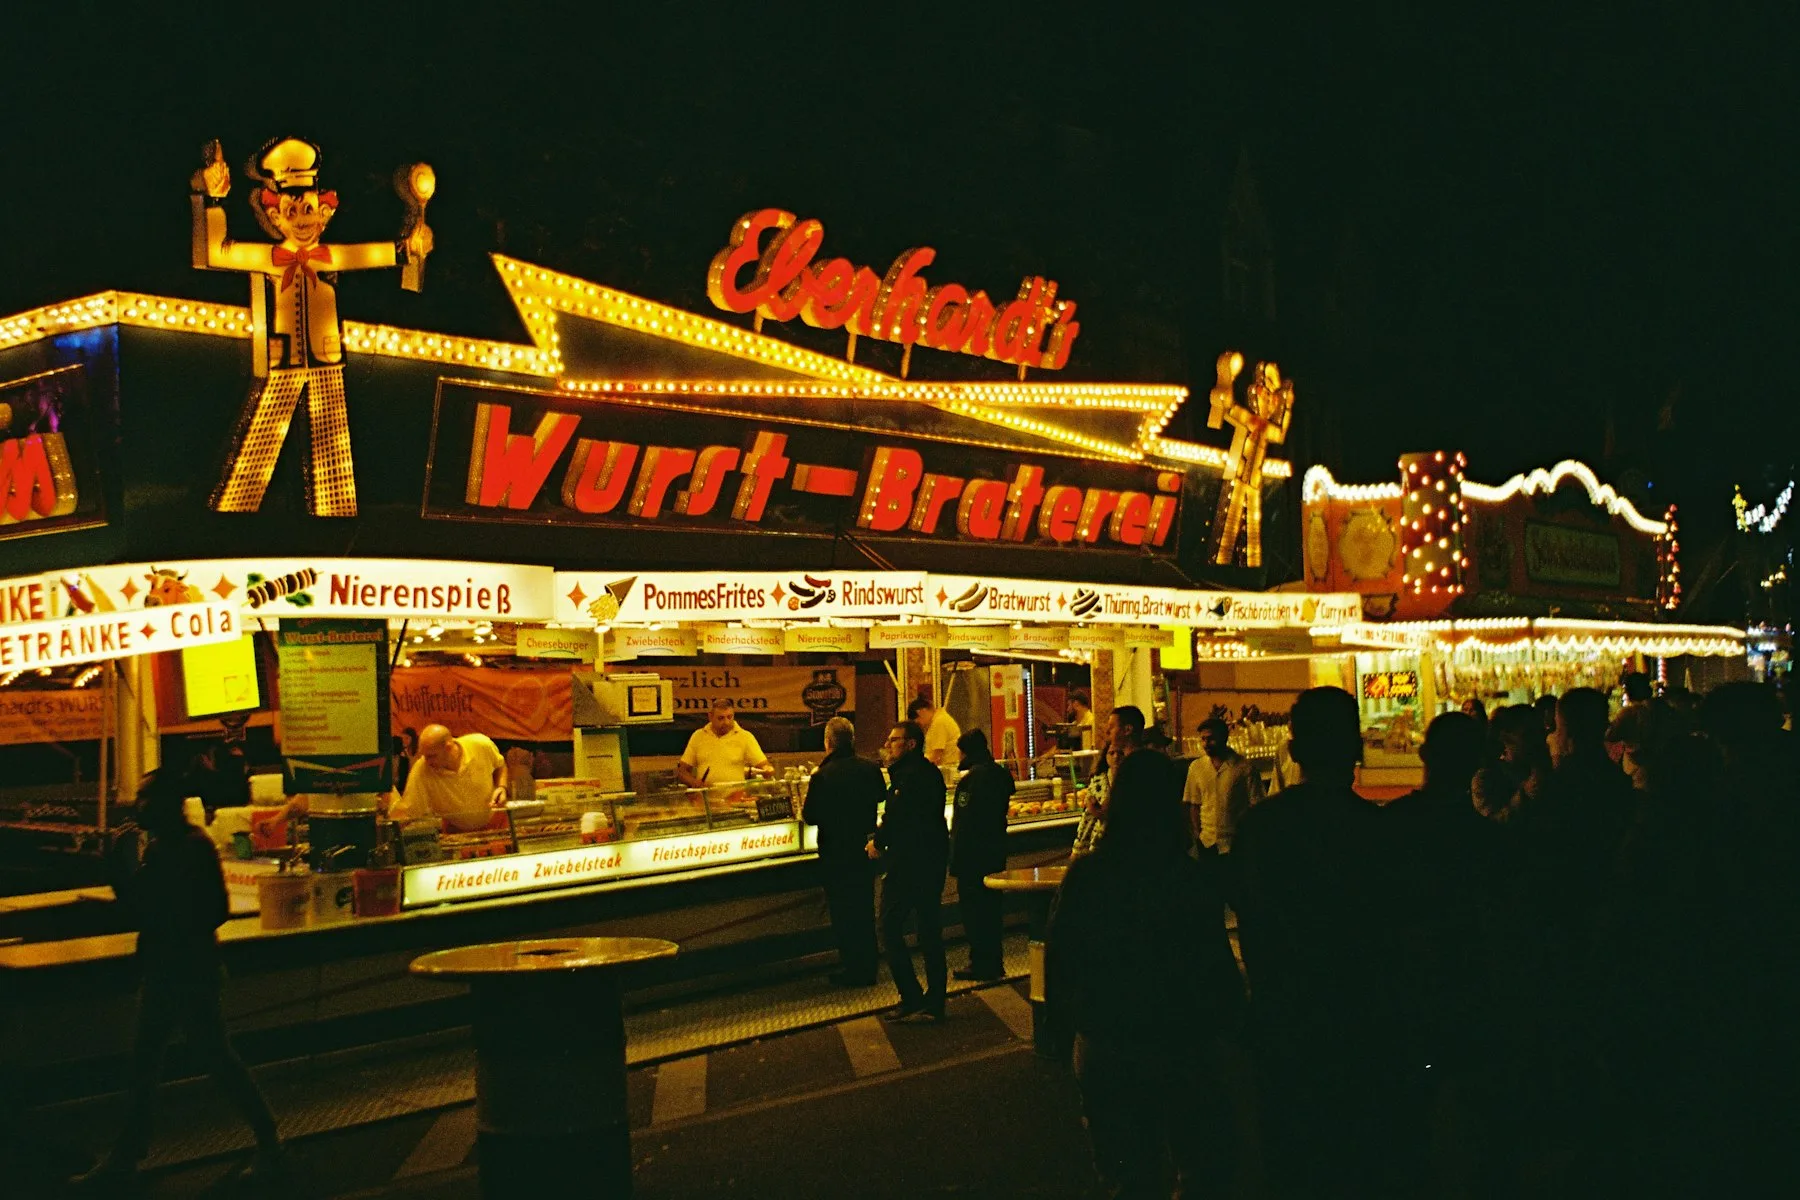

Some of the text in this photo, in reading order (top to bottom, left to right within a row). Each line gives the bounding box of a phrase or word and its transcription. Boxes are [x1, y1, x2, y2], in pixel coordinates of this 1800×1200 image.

[711, 207, 1080, 370] Eberhardt's
[330, 574, 512, 614] Nierenspieß
[842, 580, 923, 606] Rindswurst
[989, 587, 1051, 613] Bratwurst
[171, 607, 232, 638] Cola
[526, 637, 589, 651] Cheeseburger
[626, 636, 685, 647] Zwiebelsteak
[706, 635, 780, 646] Rinderhacksteak
[797, 633, 852, 644] Nierenspieß
[880, 632, 936, 642] Paprikawurst
[437, 831, 794, 892] Frikadellen Zwiebelsteak Fleischspiess Hacksteak
